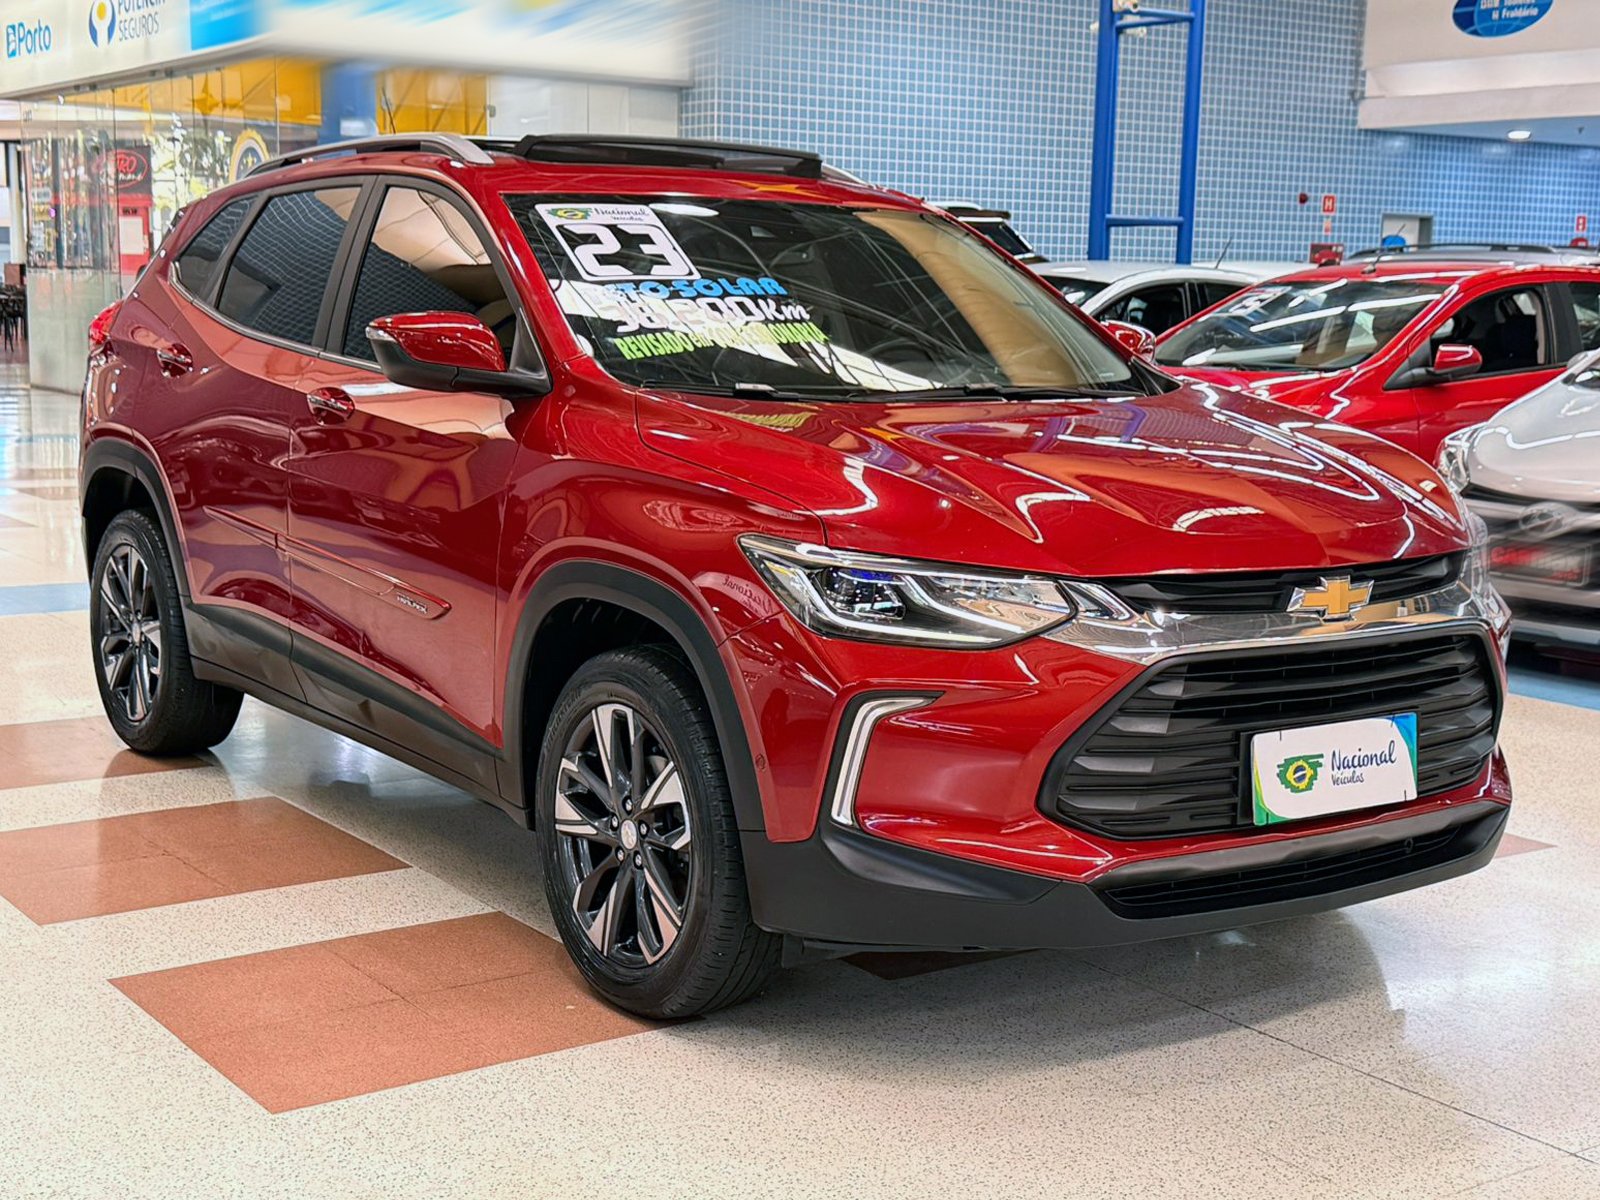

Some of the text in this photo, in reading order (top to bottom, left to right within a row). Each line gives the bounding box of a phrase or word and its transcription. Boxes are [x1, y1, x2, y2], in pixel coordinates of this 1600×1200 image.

[17, 19, 52, 56] Porto
[118, 12, 160, 42] SEGUROS
[563, 224, 690, 276] 23
[671, 277, 788, 298] SOLAR
[614, 331, 695, 360] REVISADO
[688, 331, 714, 348] em
[1331, 740, 1397, 771] Nacional
[1331, 771, 1365, 786] Veículos
